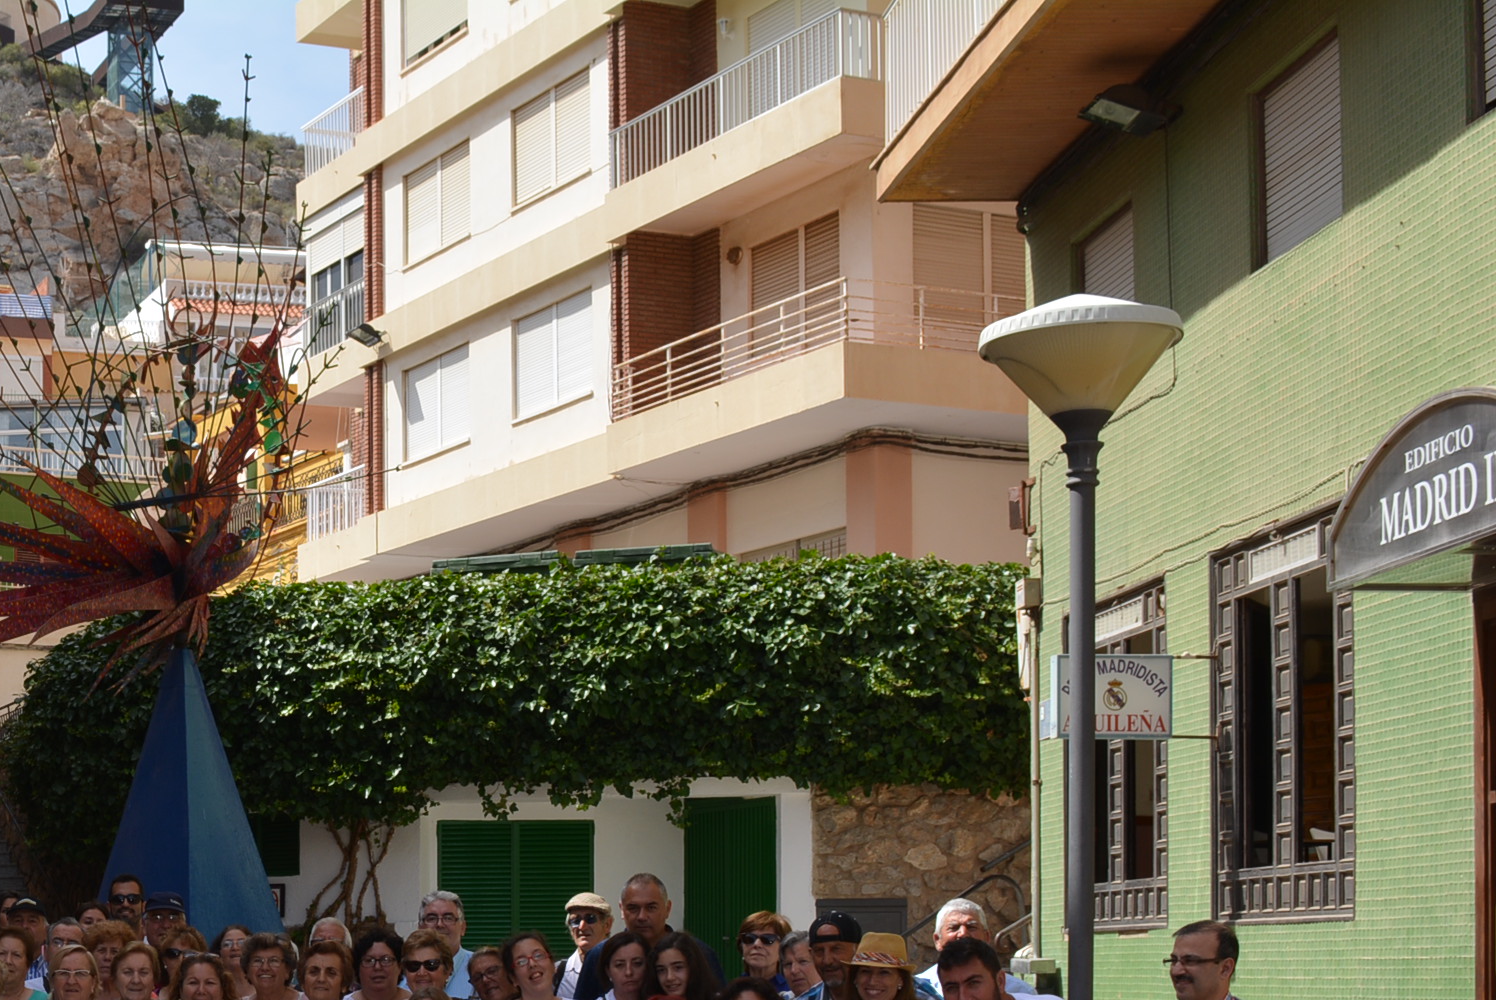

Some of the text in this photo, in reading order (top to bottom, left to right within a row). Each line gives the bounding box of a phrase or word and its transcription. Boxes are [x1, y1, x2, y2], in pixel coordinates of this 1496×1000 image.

[1404, 424, 1474, 474] EDIFICIO
[1379, 462, 1478, 546] MADRID
[1096, 659, 1168, 698] MADRIDISTA
[1062, 709, 1167, 733] AUILEÑA
